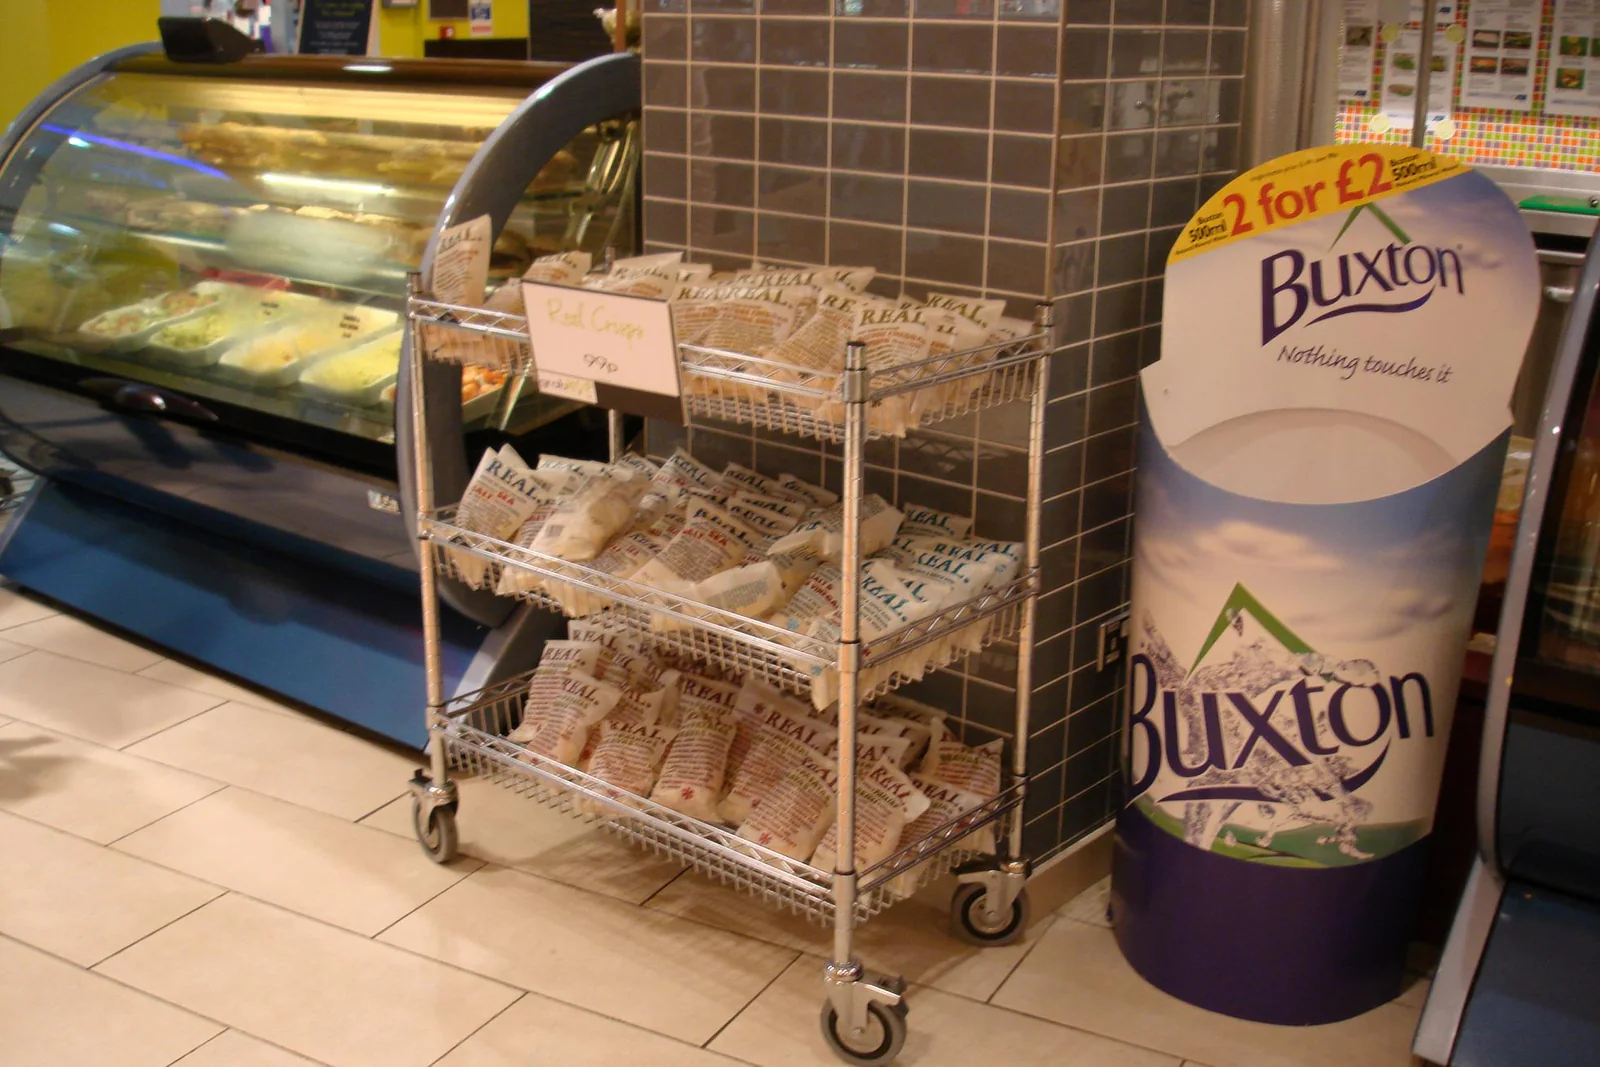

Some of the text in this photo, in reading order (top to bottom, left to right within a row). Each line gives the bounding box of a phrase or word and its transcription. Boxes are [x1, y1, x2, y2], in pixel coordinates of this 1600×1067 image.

[1223, 193, 1254, 237] 2
[1258, 181, 1326, 226] for
[1335, 153, 1394, 205] £2
[1392, 157, 1437, 182] 500ml
[1188, 219, 1228, 242] 500ml
[1261, 242, 1465, 347] Buxton
[1276, 345, 1454, 384] Nothing touches it
[1128, 652, 1435, 805] Buxton
